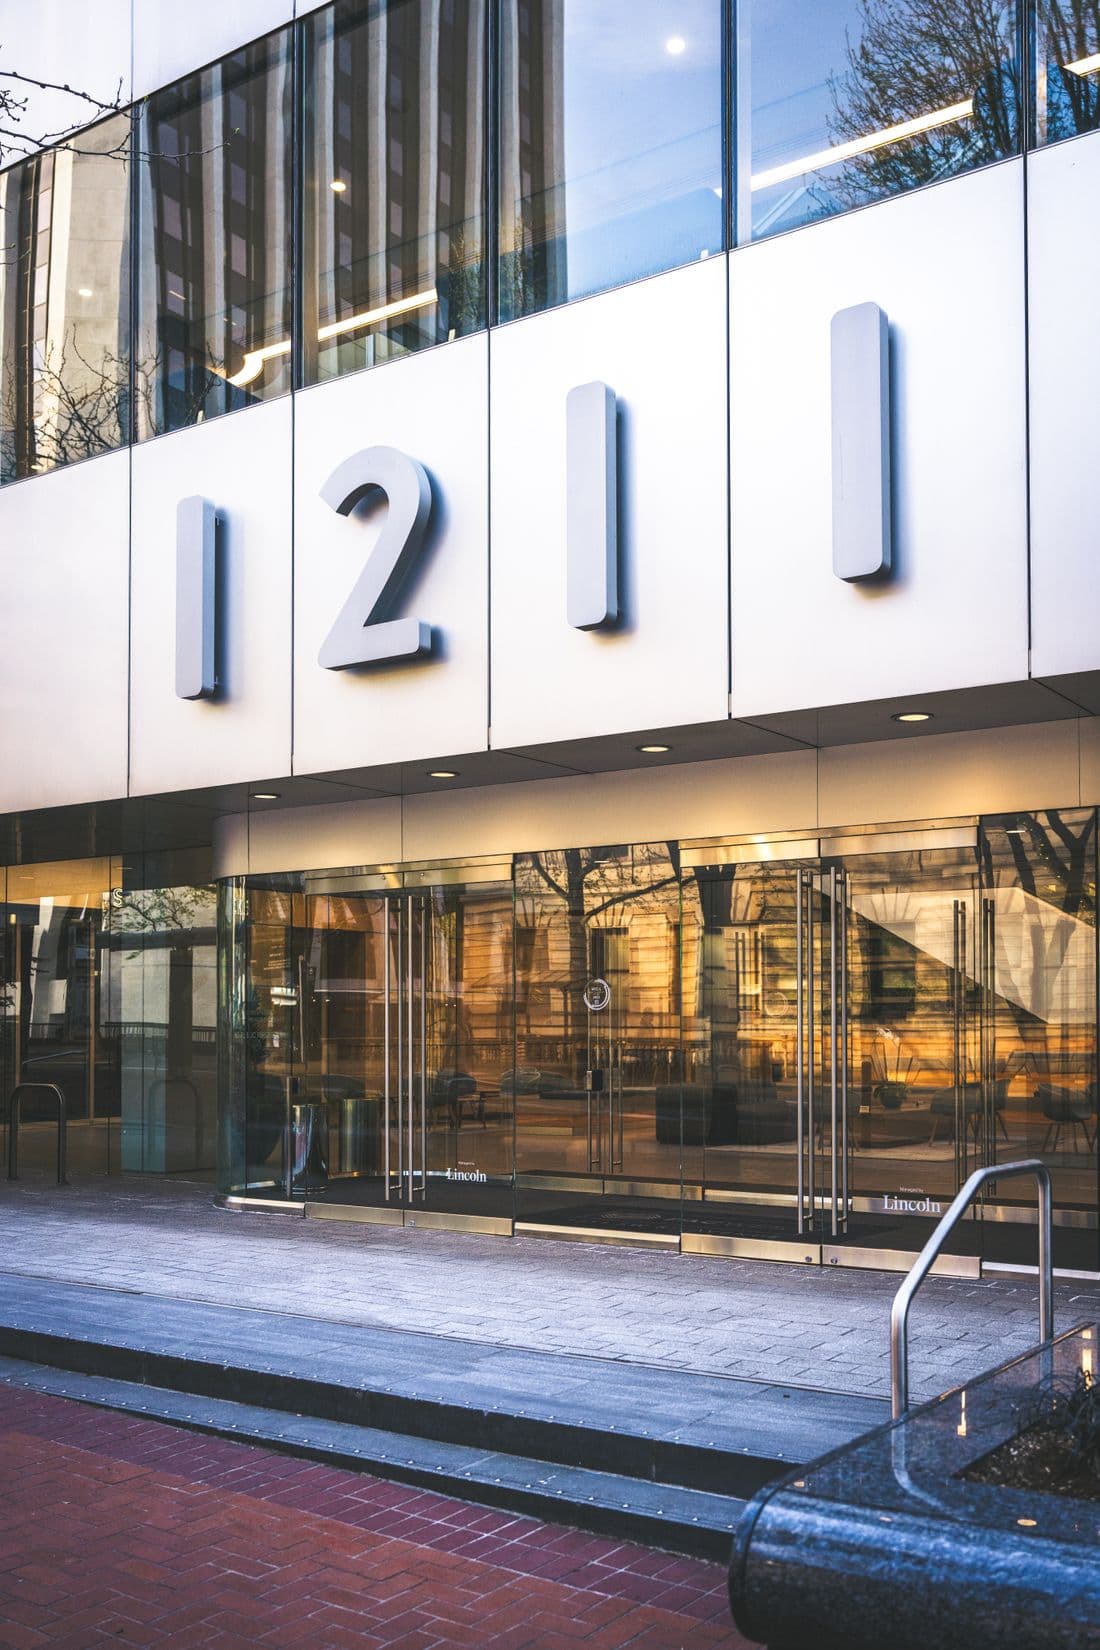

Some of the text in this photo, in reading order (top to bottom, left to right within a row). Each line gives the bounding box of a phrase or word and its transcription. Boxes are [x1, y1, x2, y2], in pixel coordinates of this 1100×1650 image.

[175, 302, 893, 701] 1211
[446, 1167, 487, 1183] Lincoln
[882, 1194, 941, 1213] Lincoln
